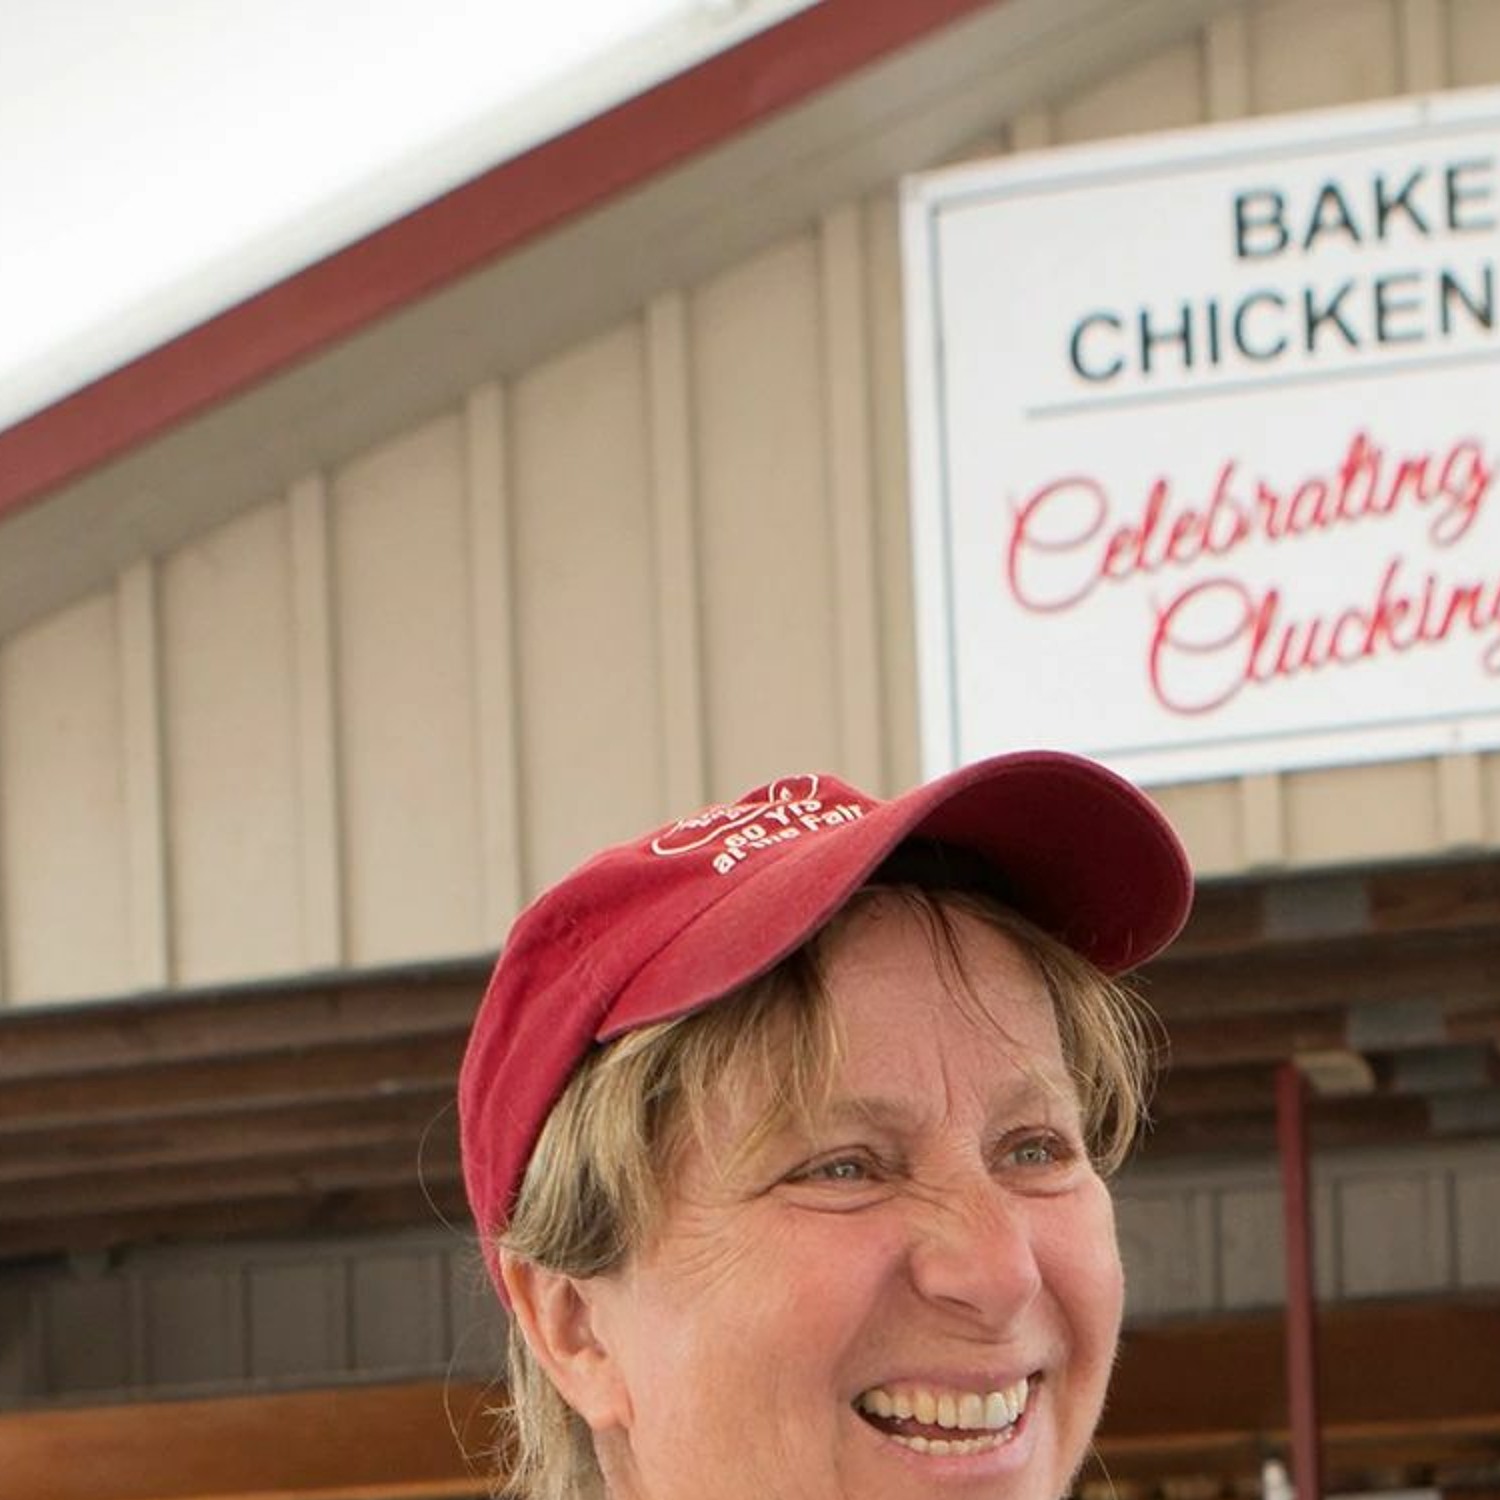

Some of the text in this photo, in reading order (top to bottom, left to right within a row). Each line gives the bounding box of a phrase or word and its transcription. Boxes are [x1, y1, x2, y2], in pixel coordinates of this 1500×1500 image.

[1067, 261, 1497, 382] CHICKEN
[1004, 431, 1499, 615] Celebrating
[799, 804, 863, 831] Fair
